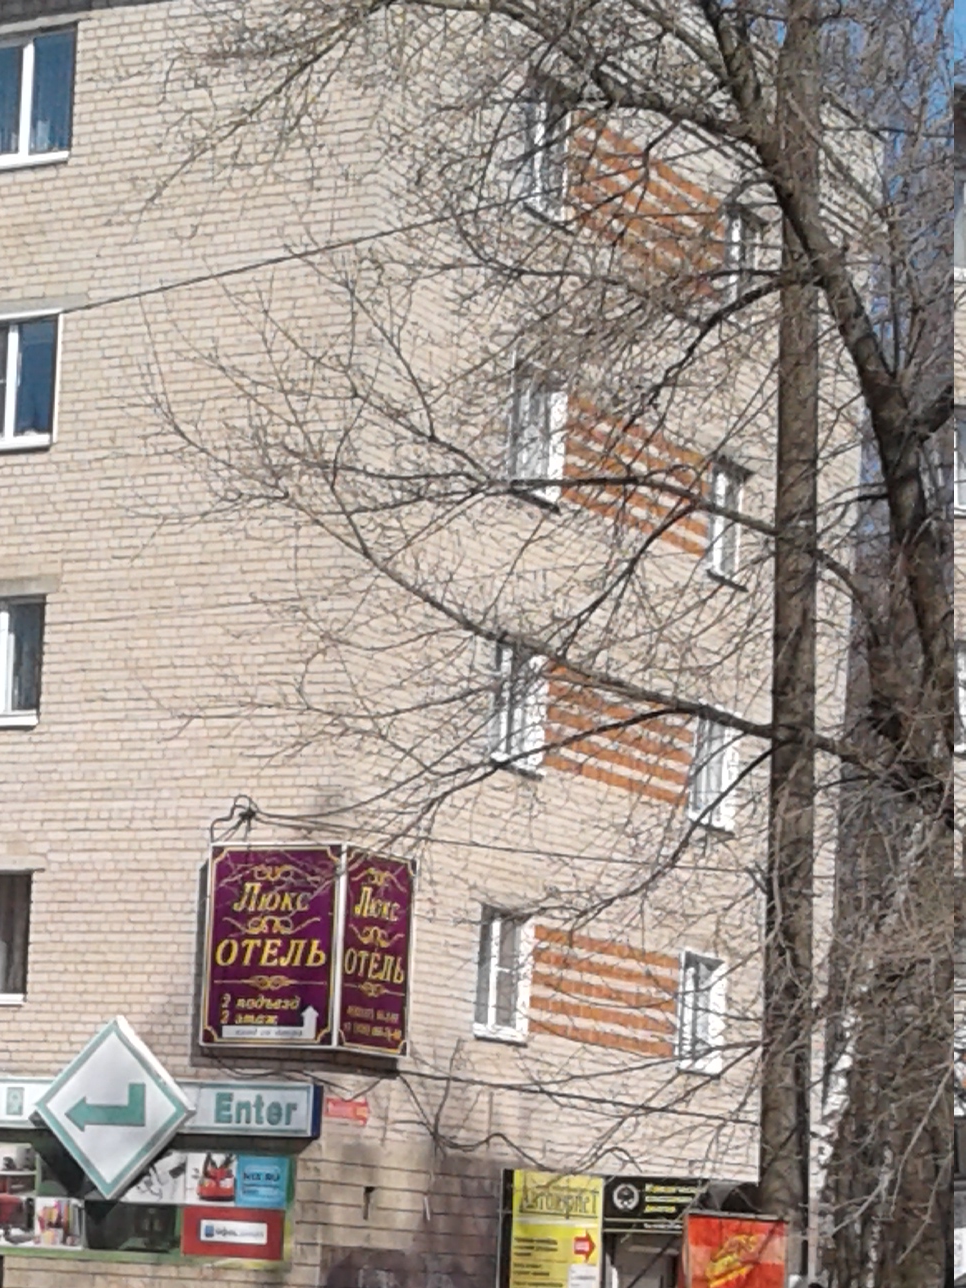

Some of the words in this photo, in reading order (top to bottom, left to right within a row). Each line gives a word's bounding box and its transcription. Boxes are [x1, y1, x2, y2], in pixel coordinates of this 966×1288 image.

[232, 882, 311, 912] Люкс
[354, 886, 401, 921] Люкс
[216, 938, 326, 966] ОТЕЛЬ
[344, 948, 405, 985] ОТЕЛЬ
[221, 993, 231, 1008] 2
[220, 1009, 230, 1024] 2
[214, 1092, 298, 1126] Enter
